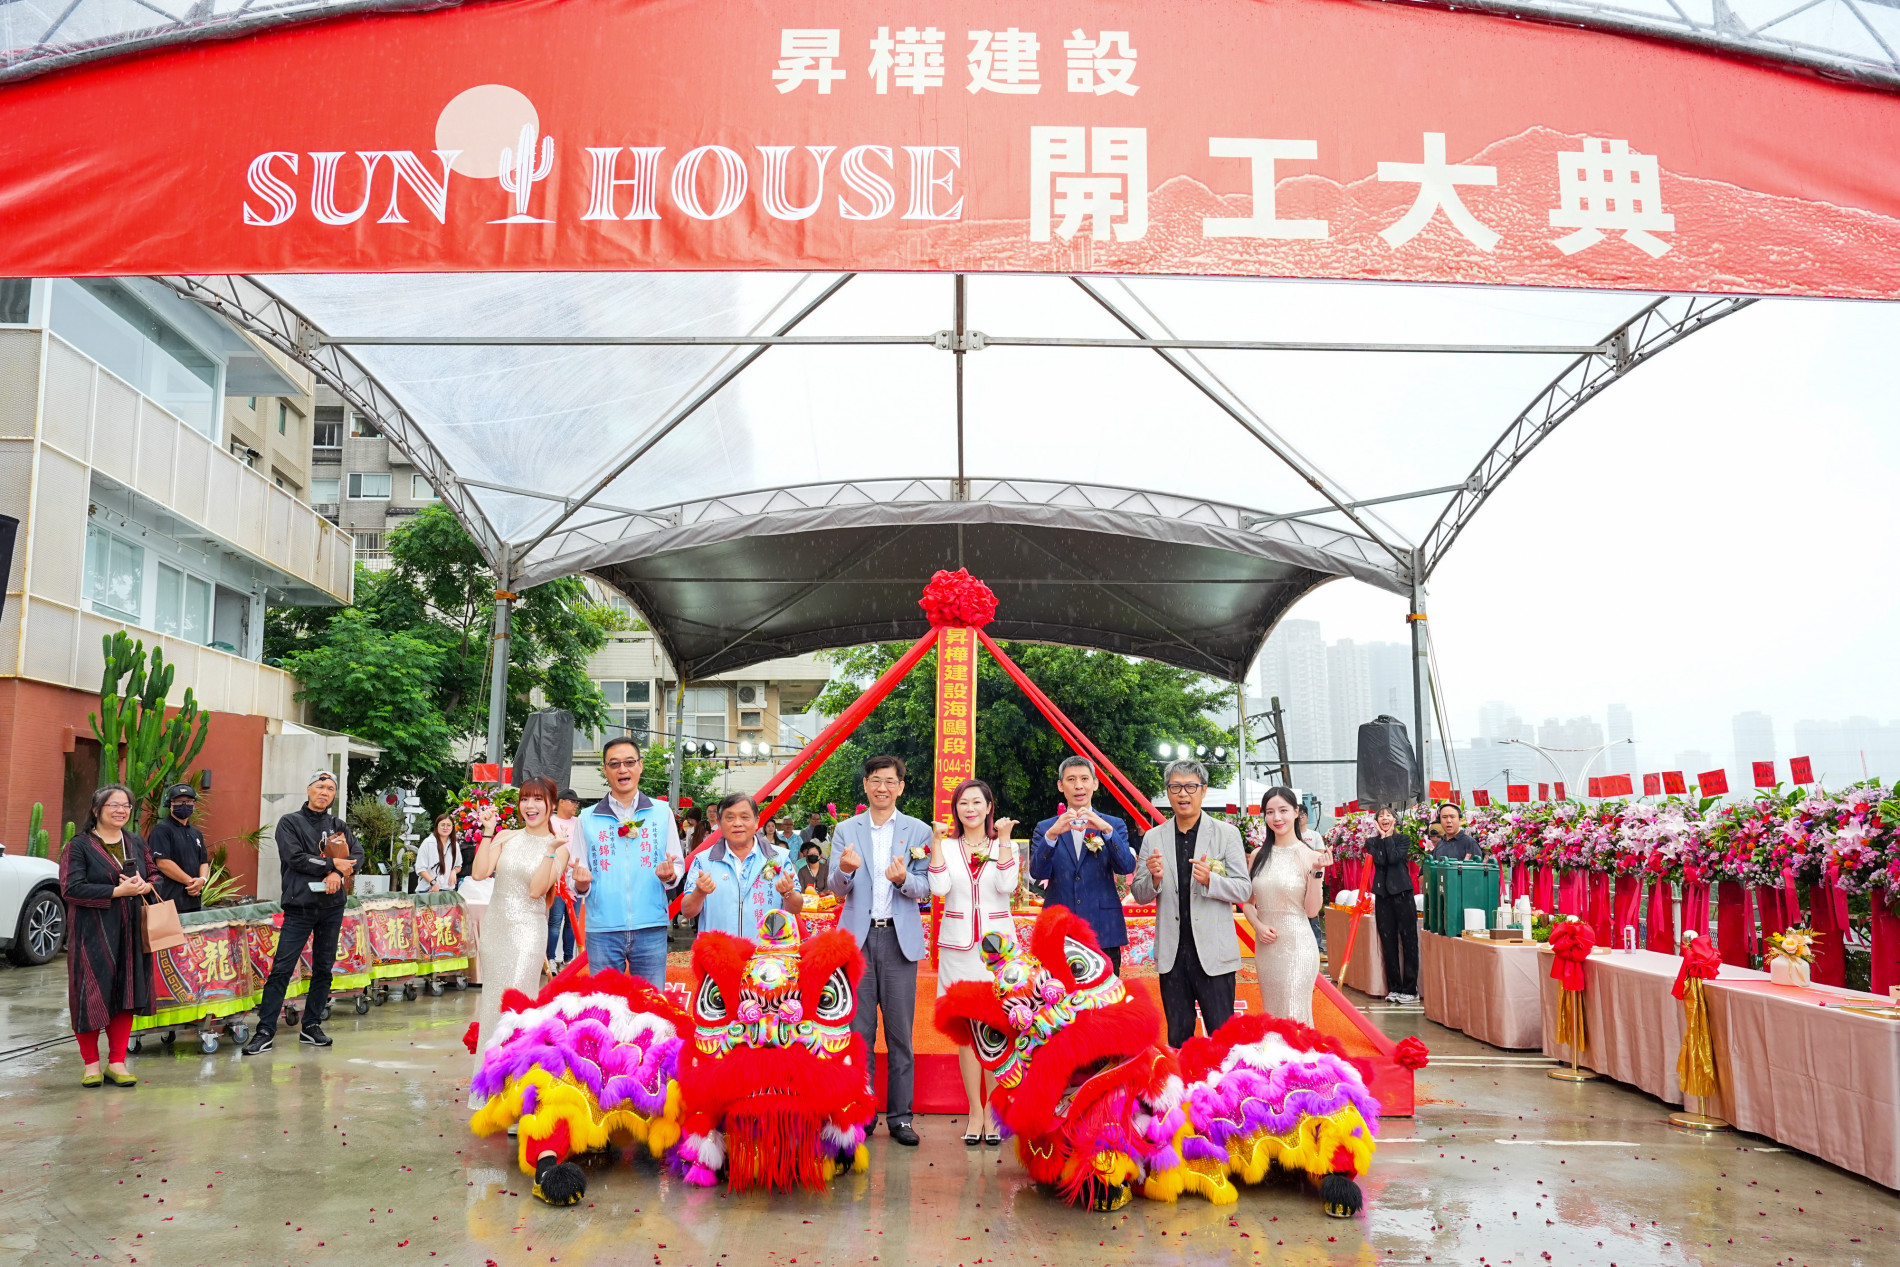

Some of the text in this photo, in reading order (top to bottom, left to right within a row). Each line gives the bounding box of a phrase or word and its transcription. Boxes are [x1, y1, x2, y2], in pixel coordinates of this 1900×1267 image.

[772, 26, 1140, 97] 昇樺建設
[243, 145, 965, 226] SUN HOUSE
[1029, 125, 1676, 259] 開工大典
[598, 830, 611, 871] 蔡錦賢
[383, 917, 410, 951] 龍
[431, 915, 458, 948] 龍
[199, 938, 237, 983] 龍
